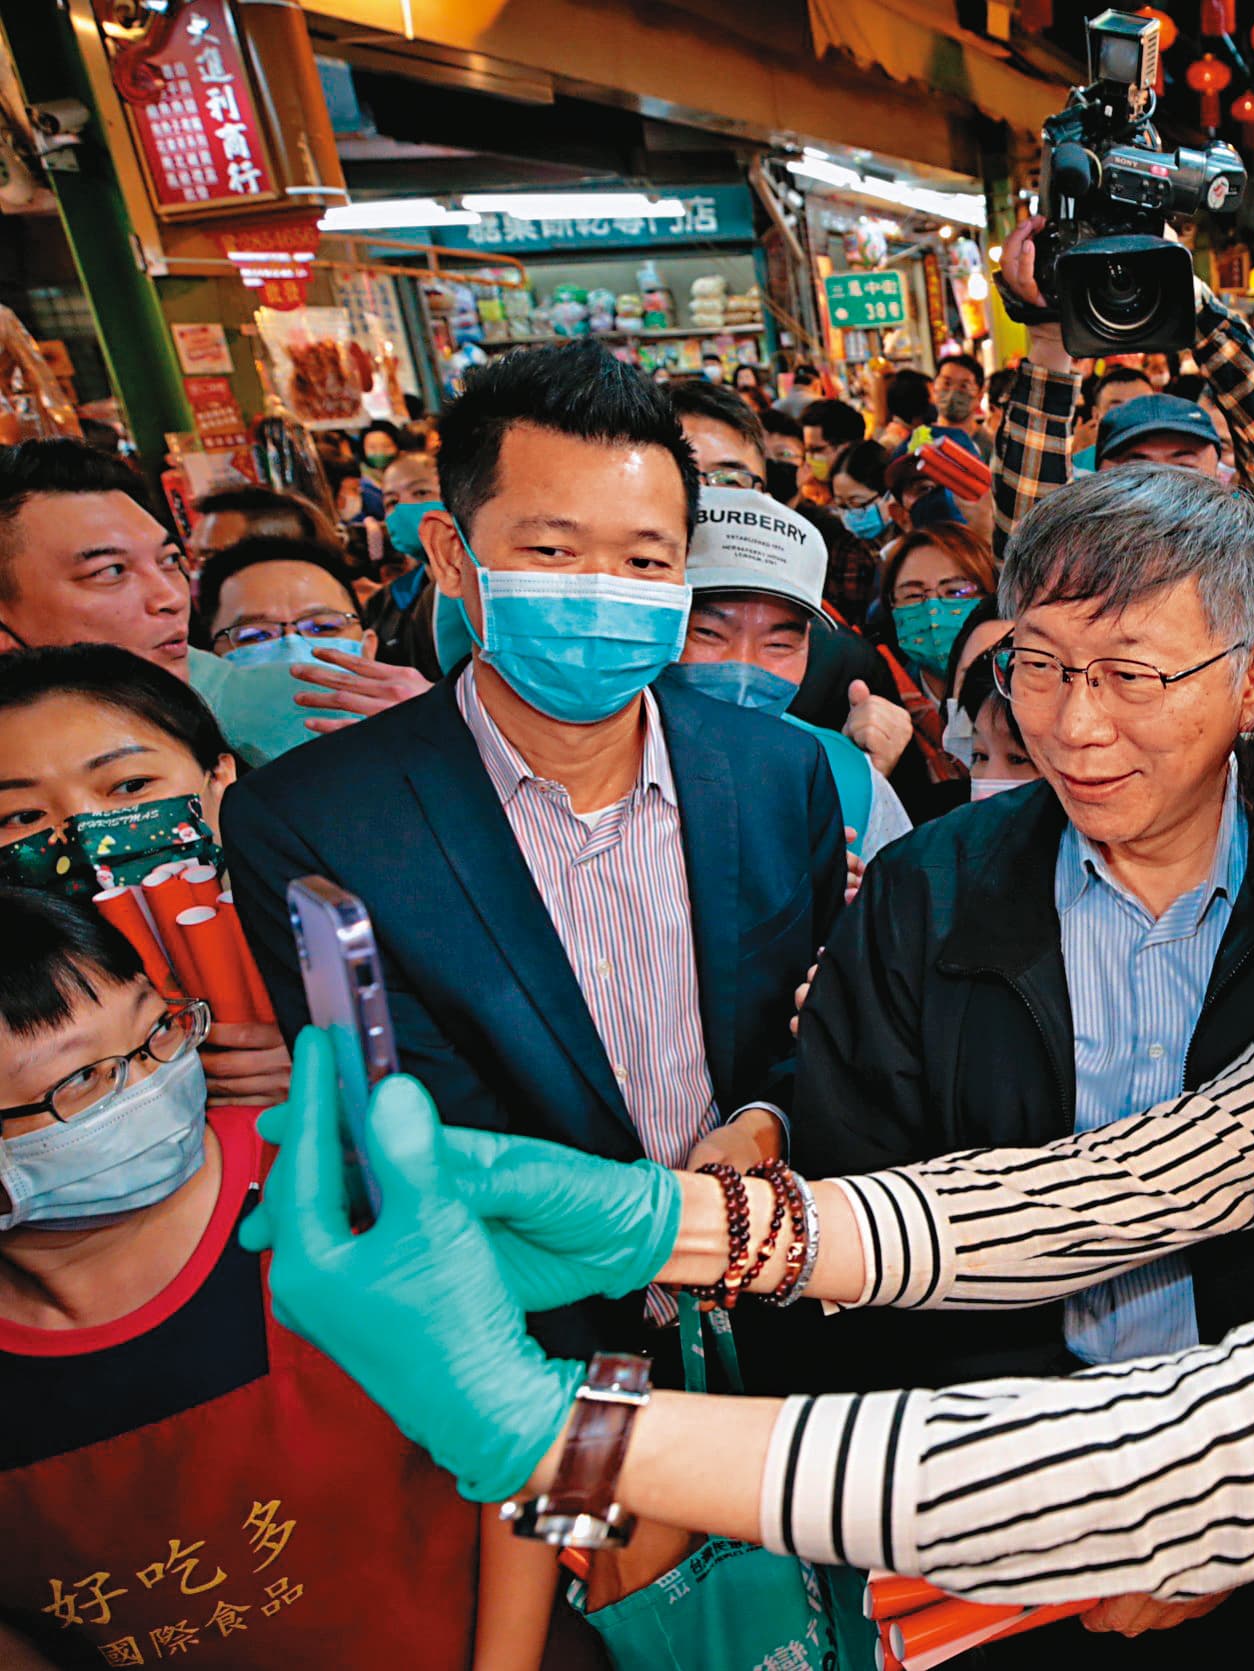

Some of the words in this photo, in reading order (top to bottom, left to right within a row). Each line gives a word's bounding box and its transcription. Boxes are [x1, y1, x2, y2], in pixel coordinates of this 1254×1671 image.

[1114, 157, 1138, 168] SONY
[696, 509, 807, 545] BURBERRY
[41, 1499, 297, 1629] 好吃多
[97, 1576, 304, 1668] 國際食品
